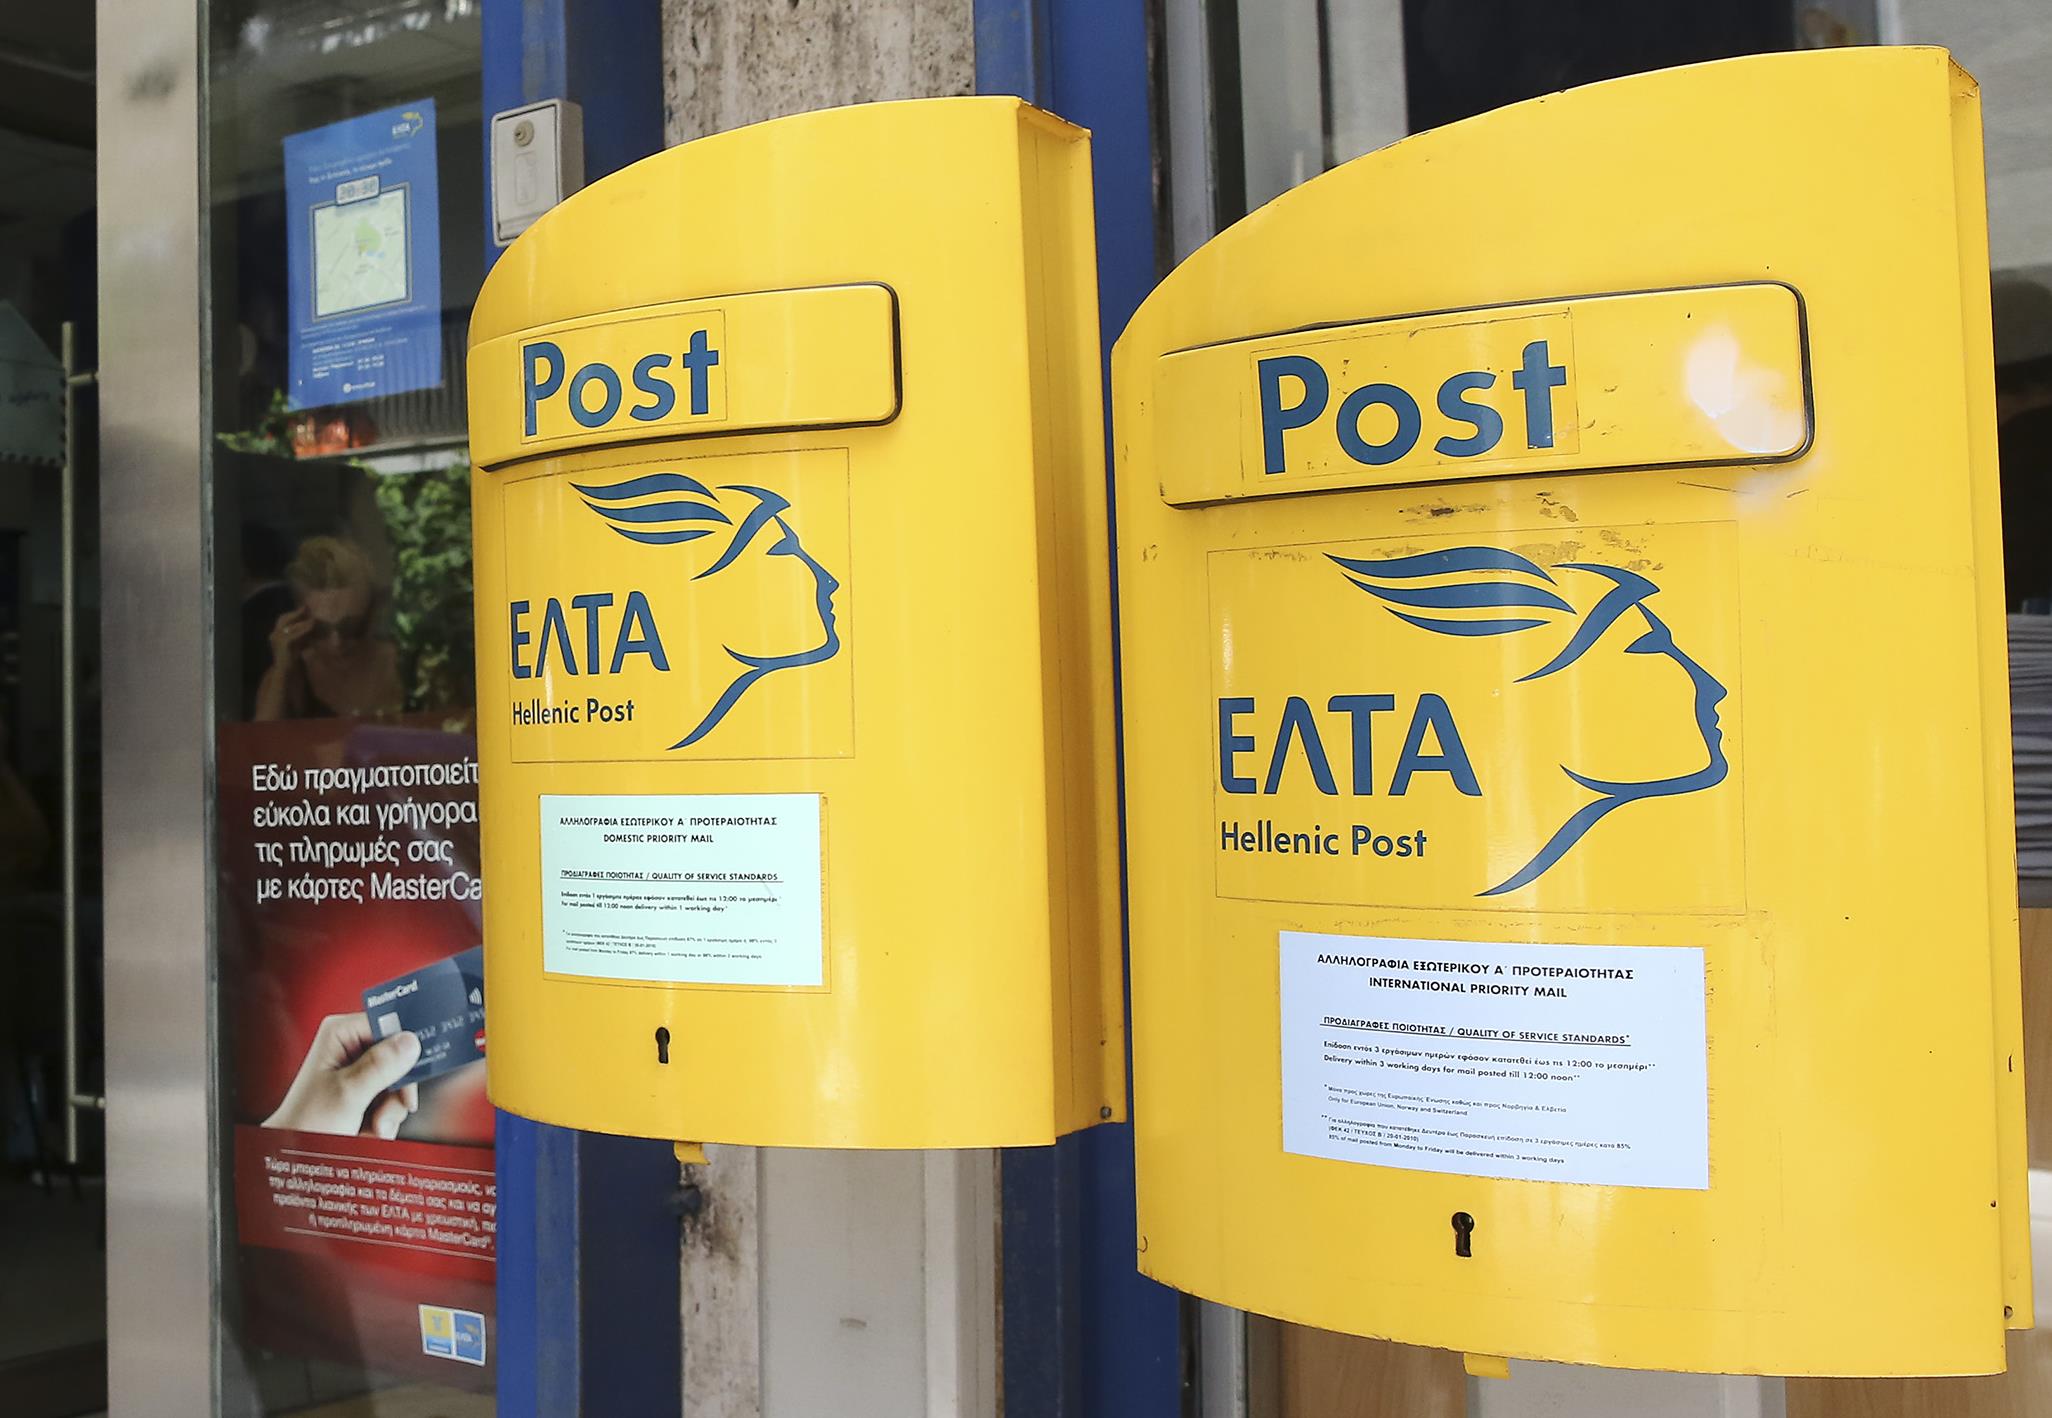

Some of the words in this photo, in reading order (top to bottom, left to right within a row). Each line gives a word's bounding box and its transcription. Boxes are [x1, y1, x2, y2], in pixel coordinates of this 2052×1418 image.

[523, 330, 718, 437] Post
[1257, 340, 1567, 474] Post
[510, 591, 670, 679] ΕΛΤΑ
[513, 699, 580, 725] Hellenic
[587, 698, 634, 723] Post
[1218, 693, 1483, 797] ΕΛΤΑ
[252, 763, 298, 792] Εδώ
[253, 800, 331, 828] εύκολα
[336, 803, 371, 826] και
[376, 796, 478, 831] γρήγορα
[560, 817, 618, 826] ΑΛΛΗΛΟΓΡΑΦΙΑ
[620, 817, 674, 826] ΕΣΩΤΕΡΙΚΟΥ
[690, 817, 777, 826] ΠΡΟΤΕΡΑΙΟΤΗΤΑΣ
[254, 841, 283, 868] τις
[289, 835, 400, 868] πληρωμές
[407, 839, 454, 866] σας
[603, 834, 644, 843] DOMESTIC
[646, 834, 687, 843] PRIORITY
[690, 834, 714, 843] MAIL
[1221, 819, 1339, 855] Hellenic
[1352, 824, 1427, 858] Post
[256, 878, 282, 904] με
[288, 872, 364, 905] κάρτες
[561, 869, 604, 878] ΠΡΟΔΙΑΓΡΑΦΕΣ
[606, 871, 643, 879] ΠΟΙΟΤΗΤΑΣ
[652, 872, 682, 880] QUALITY
[729, 873, 778, 881] STANDARDS
[1317, 954, 1409, 970] ΑΛΛΗΛΟΓΡΑΦΙΑ
[1413, 960, 1490, 975] ΕΞΩΤΕΡΙΚΟΥ
[1512, 965, 1634, 980] ΠΡΟΤΕΡΑΙΟΤΗΤΑΣ
[368, 979, 419, 1008] MasterCard
[1369, 977, 1466, 993] INTERNATIONAL
[1470, 983, 1529, 996] PRIORITY
[1534, 987, 1567, 998] MAIL
[1323, 1016, 1389, 1030] ΠΡΟΔΙΑΓΡΑΦΕΣ
[1392, 1022, 1446, 1035] ΠΟΙΟΤΗΤΑΣ
[1457, 1027, 1499, 1038] QUALITY
[1502, 1030, 1516, 1039] OF
[1519, 1031, 1559, 1041] SERVICE
[1323, 1054, 1352, 1065] Delivery
[1354, 1059, 1378, 1067] within
[1386, 1062, 1419, 1072] working
[1421, 1064, 1441, 1074] days
[1478, 1070, 1507, 1078] posted
[1523, 1072, 1548, 1080] 12:00
[1353, 1044, 1373, 1053] εντός
[1381, 1048, 1423, 1058] εργάσιμων
[1424, 1051, 1456, 1060] ημερών
[1457, 1053, 1490, 1062] εφόσον
[1491, 1056, 1532, 1065] κατατεθεί
[1534, 1058, 1550, 1066] έως
[1567, 1060, 1592, 1068] 12:00
[1350, 1099, 1376, 1107] European
[1397, 1104, 1418, 1112] Norway
[1433, 1107, 1468, 1116] Switzerland
[1522, 1155, 1547, 1163] working
